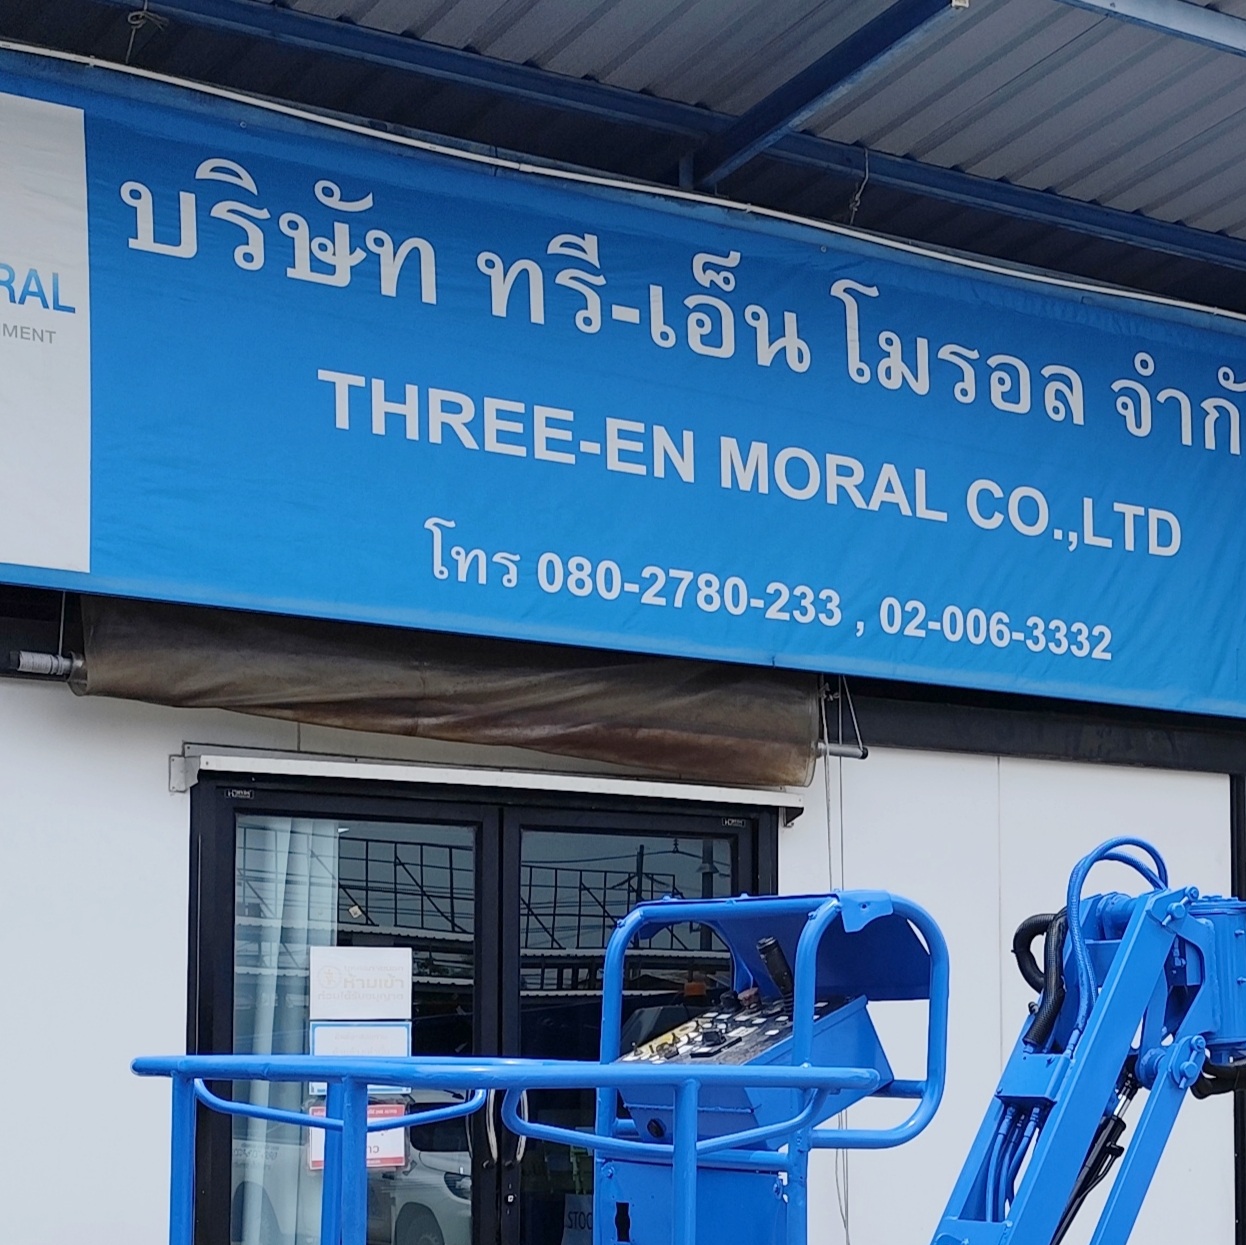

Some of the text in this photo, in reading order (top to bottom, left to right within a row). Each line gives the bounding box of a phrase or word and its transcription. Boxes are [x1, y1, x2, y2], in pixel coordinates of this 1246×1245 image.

[120, 158, 437, 304] บริษัท
[477, 234, 811, 373] ทรี-เอ็น
[831, 279, 1085, 425] โมรอล
[317, 369, 1182, 556] THREE-EN MORAL CO.,LTD
[424, 517, 520, 588] โทร
[537, 552, 842, 626] 080-2780-233
[879, 597, 1112, 660] 02-006-3332
